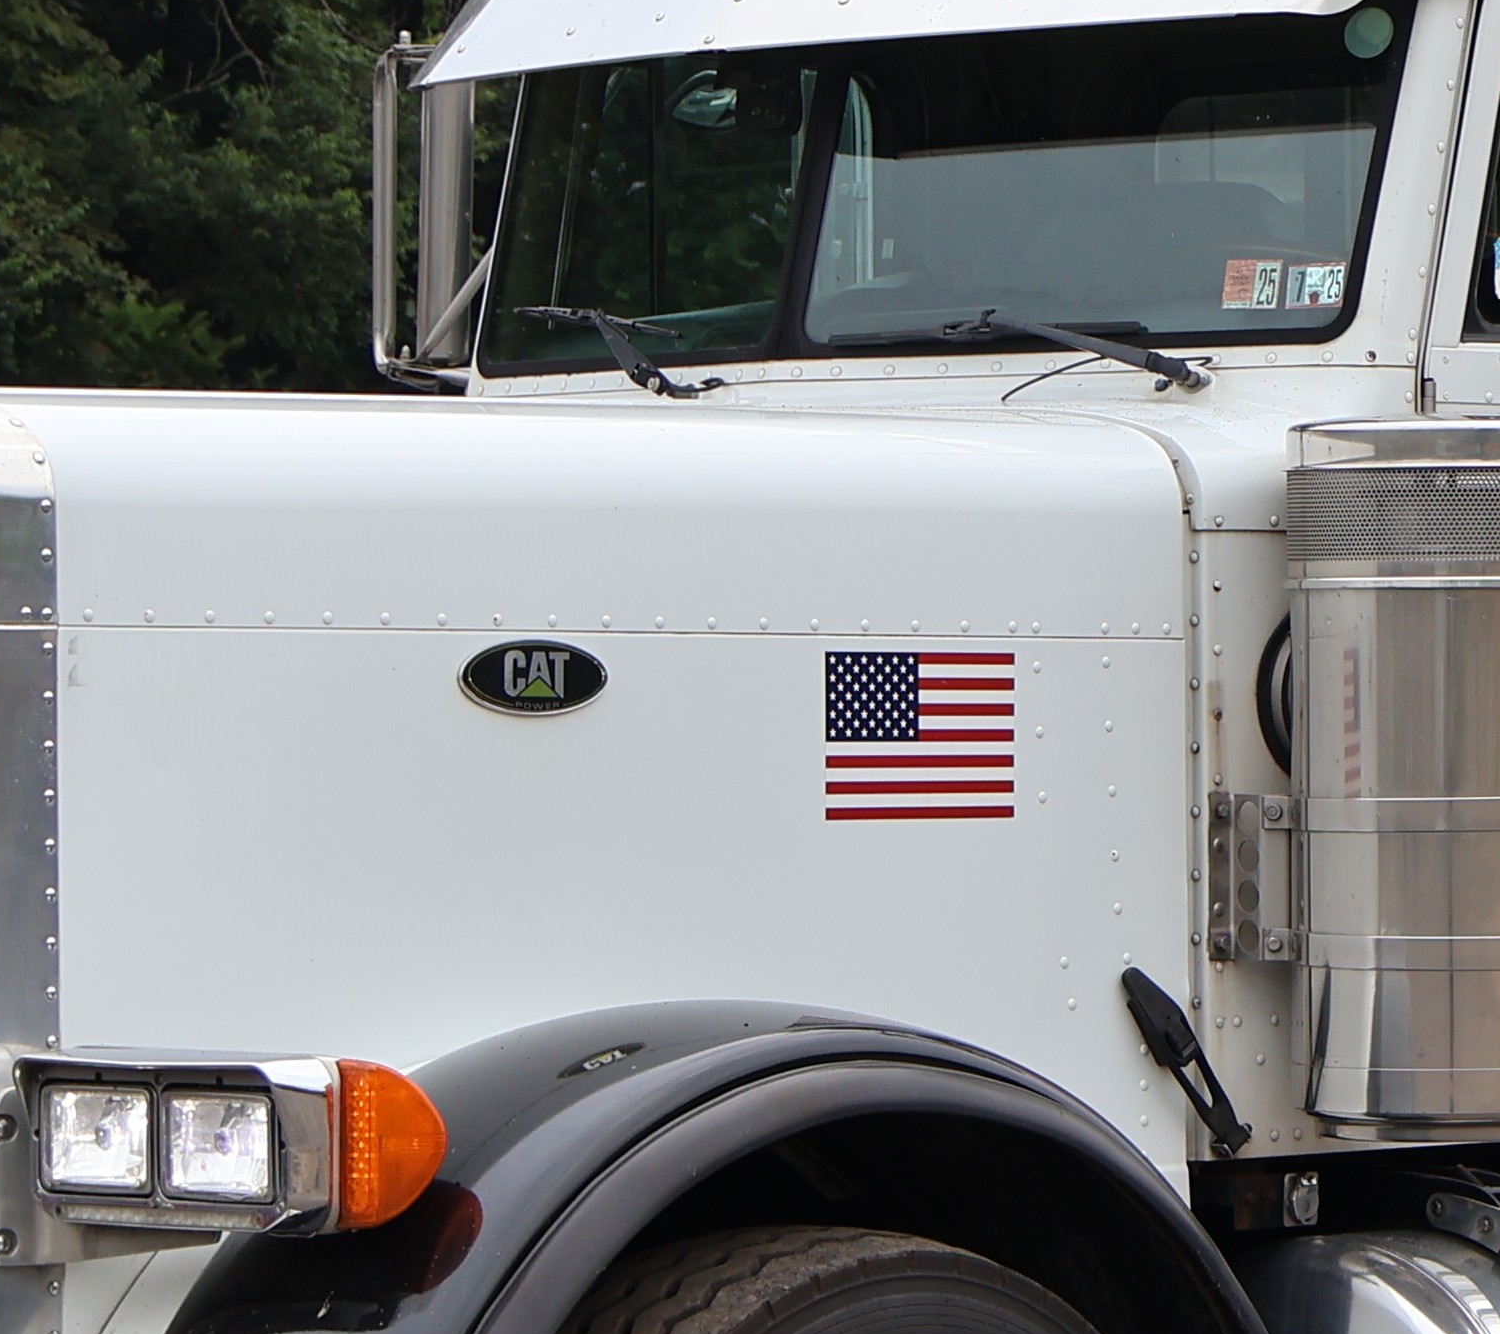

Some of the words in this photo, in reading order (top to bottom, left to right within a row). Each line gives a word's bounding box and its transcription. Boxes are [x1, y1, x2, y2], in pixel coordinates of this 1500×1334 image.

[1256, 268, 1277, 305] 25
[1295, 271, 1307, 303] 7
[1327, 269, 1343, 299] 25
[504, 649, 570, 699] CAT
[515, 701, 560, 710] POWER
